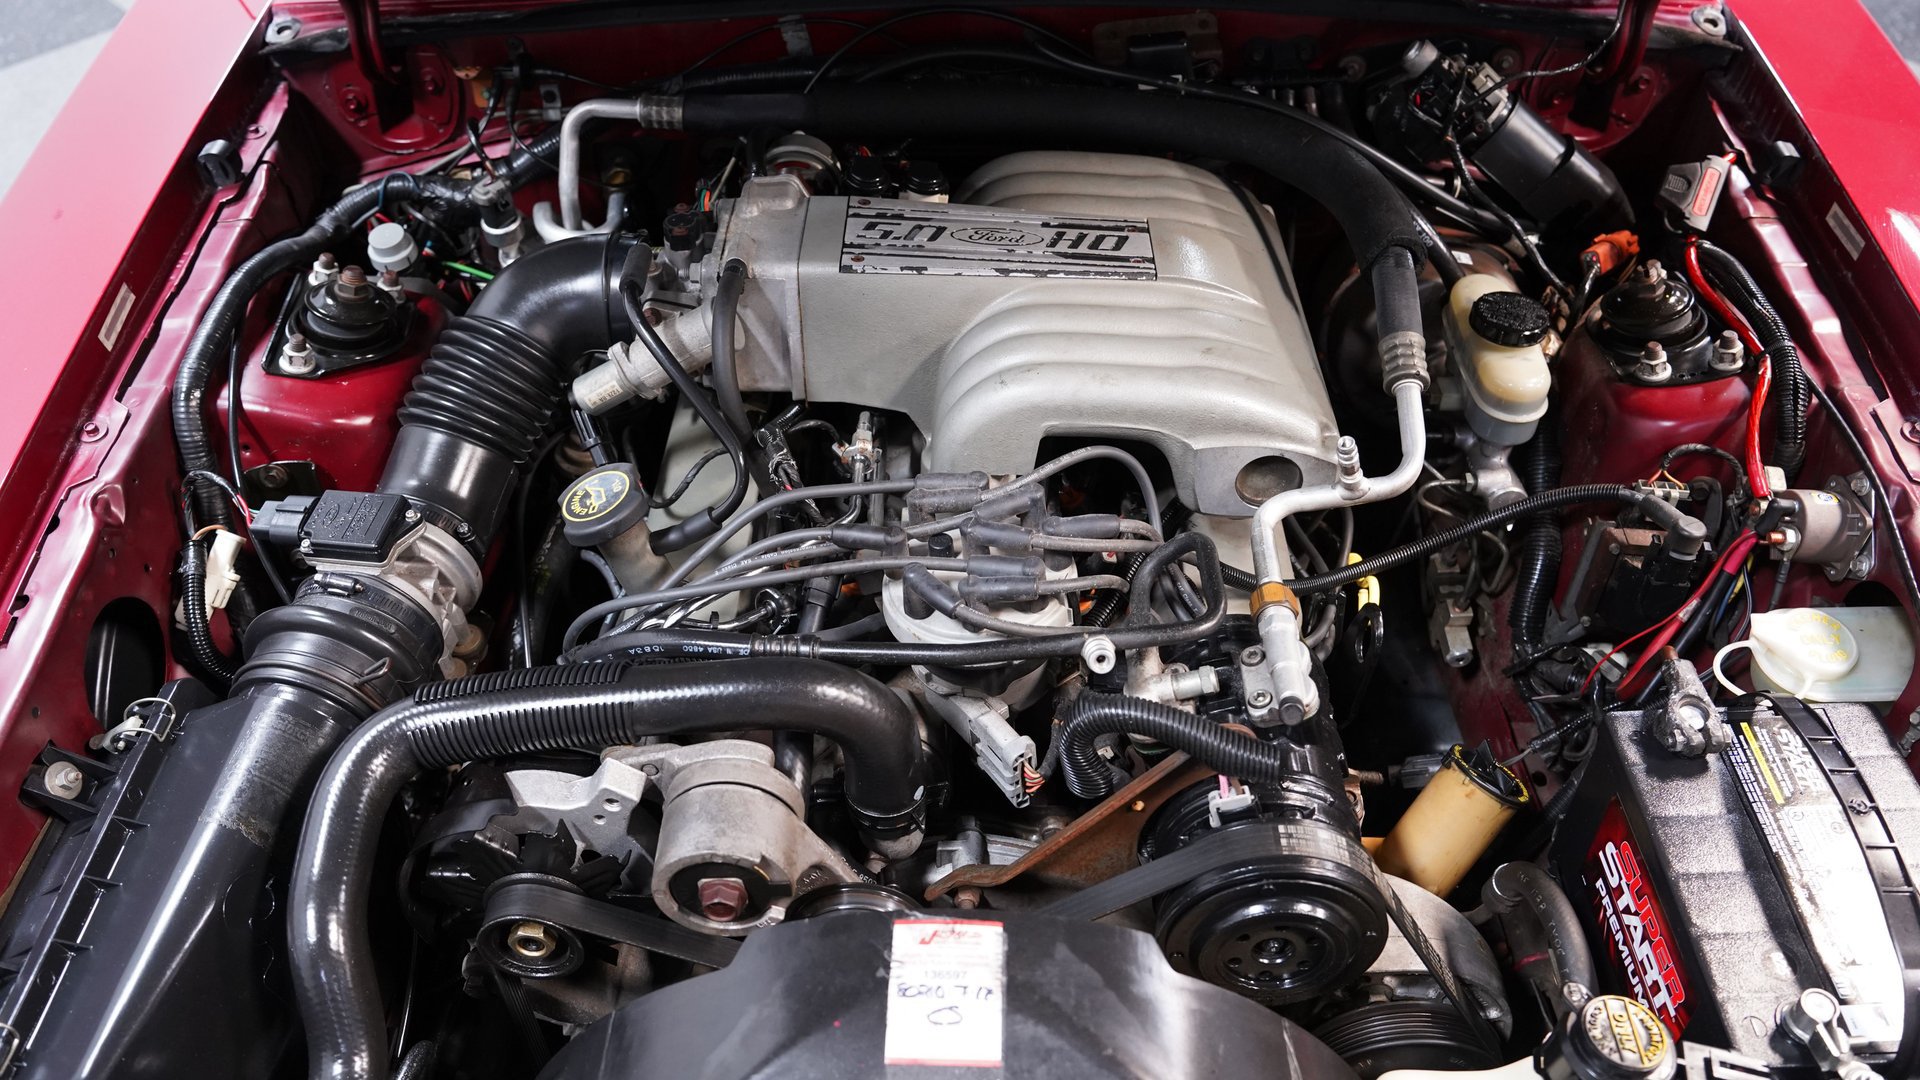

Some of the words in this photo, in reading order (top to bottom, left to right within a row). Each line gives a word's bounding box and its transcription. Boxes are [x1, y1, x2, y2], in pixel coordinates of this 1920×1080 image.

[964, 227, 1027, 246] Ford
[570, 489, 589, 516] ENGINE
[1595, 877, 1650, 1010] PREMIUM
[1599, 841, 1676, 1018] START
[1616, 840, 1686, 1008] SUPER
